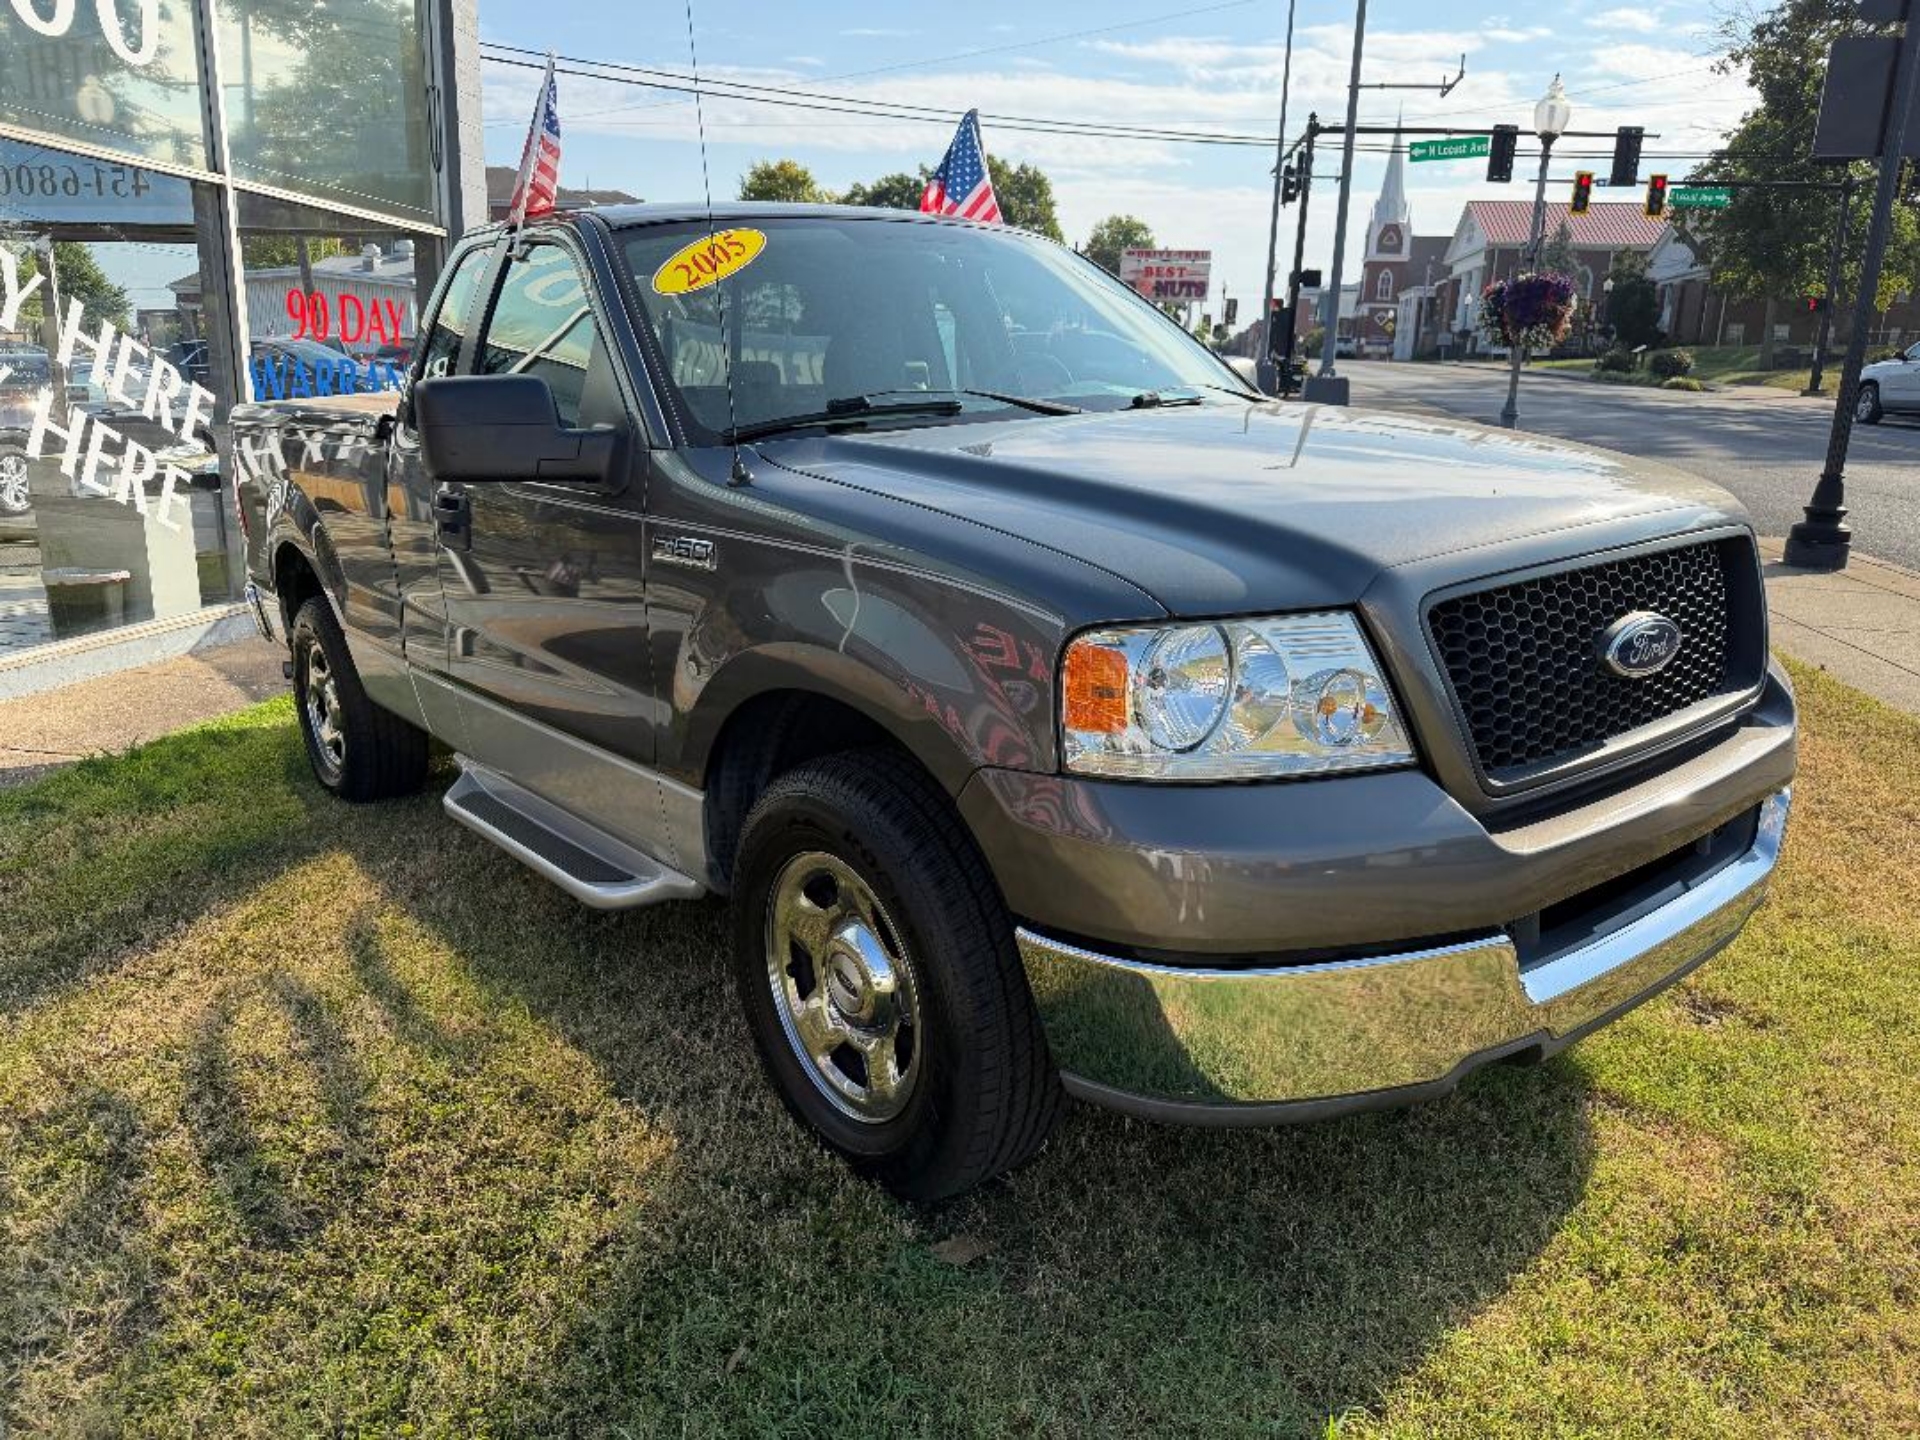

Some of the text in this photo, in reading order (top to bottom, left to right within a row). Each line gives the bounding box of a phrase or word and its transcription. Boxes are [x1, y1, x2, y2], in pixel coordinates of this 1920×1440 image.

[1438, 144, 1468, 156] Locust
[674, 231, 746, 287] 2005
[1143, 266, 1187, 278] BEST
[286, 288, 405, 349] 90 DAY
[56, 295, 216, 452] HERE
[26, 386, 192, 533] HERE
[1630, 629, 1668, 664] Ford
